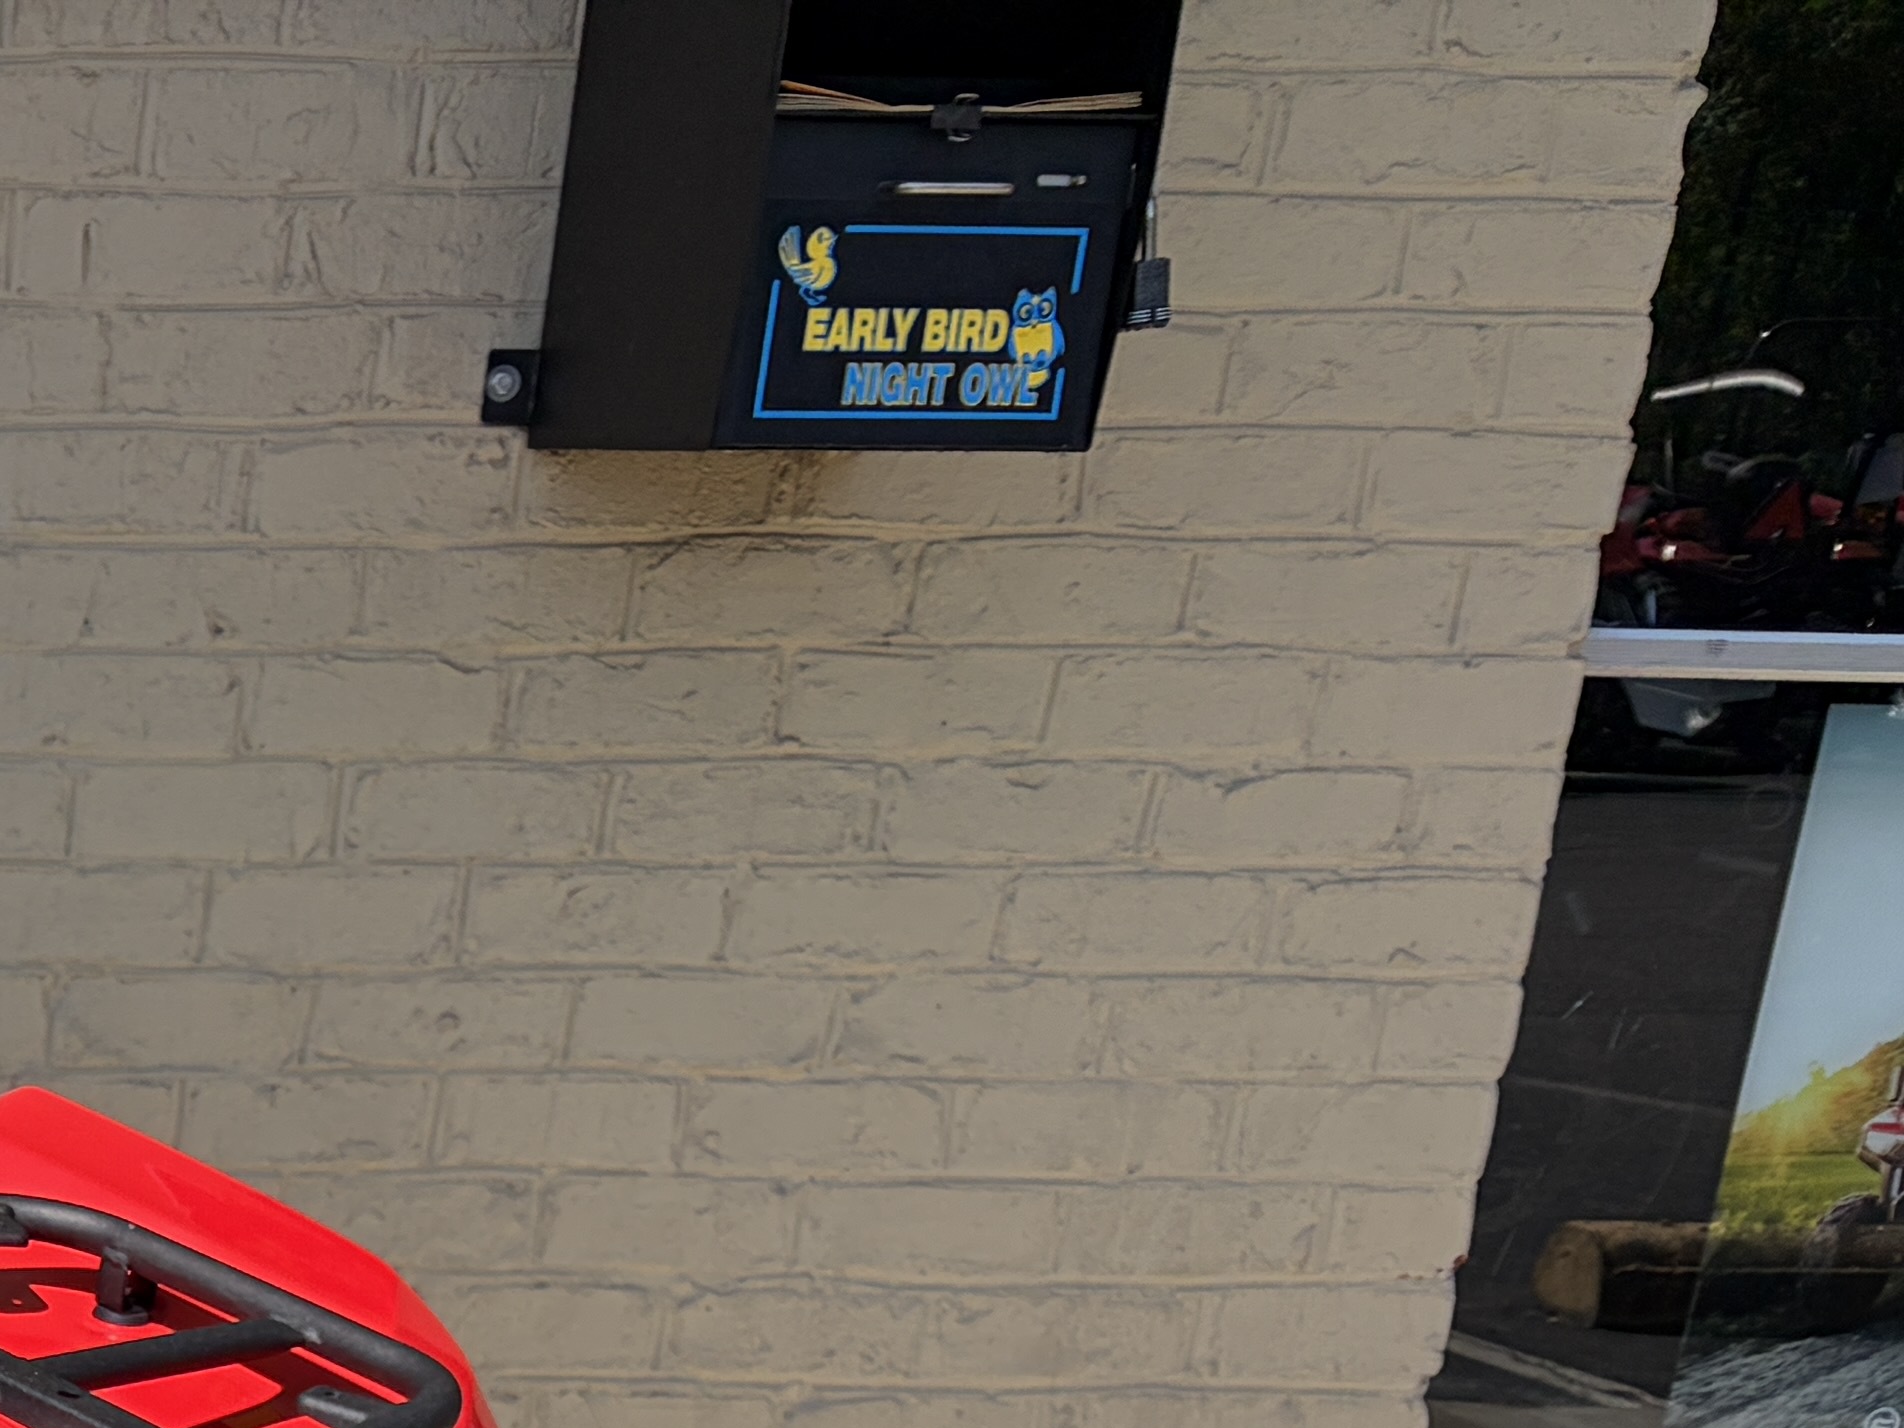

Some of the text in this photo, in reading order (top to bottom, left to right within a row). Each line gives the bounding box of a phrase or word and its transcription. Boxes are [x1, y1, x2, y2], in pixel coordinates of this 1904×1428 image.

[802, 308, 1010, 352] EARLY BIRD
[841, 362, 1039, 406] NIGHT OWL
